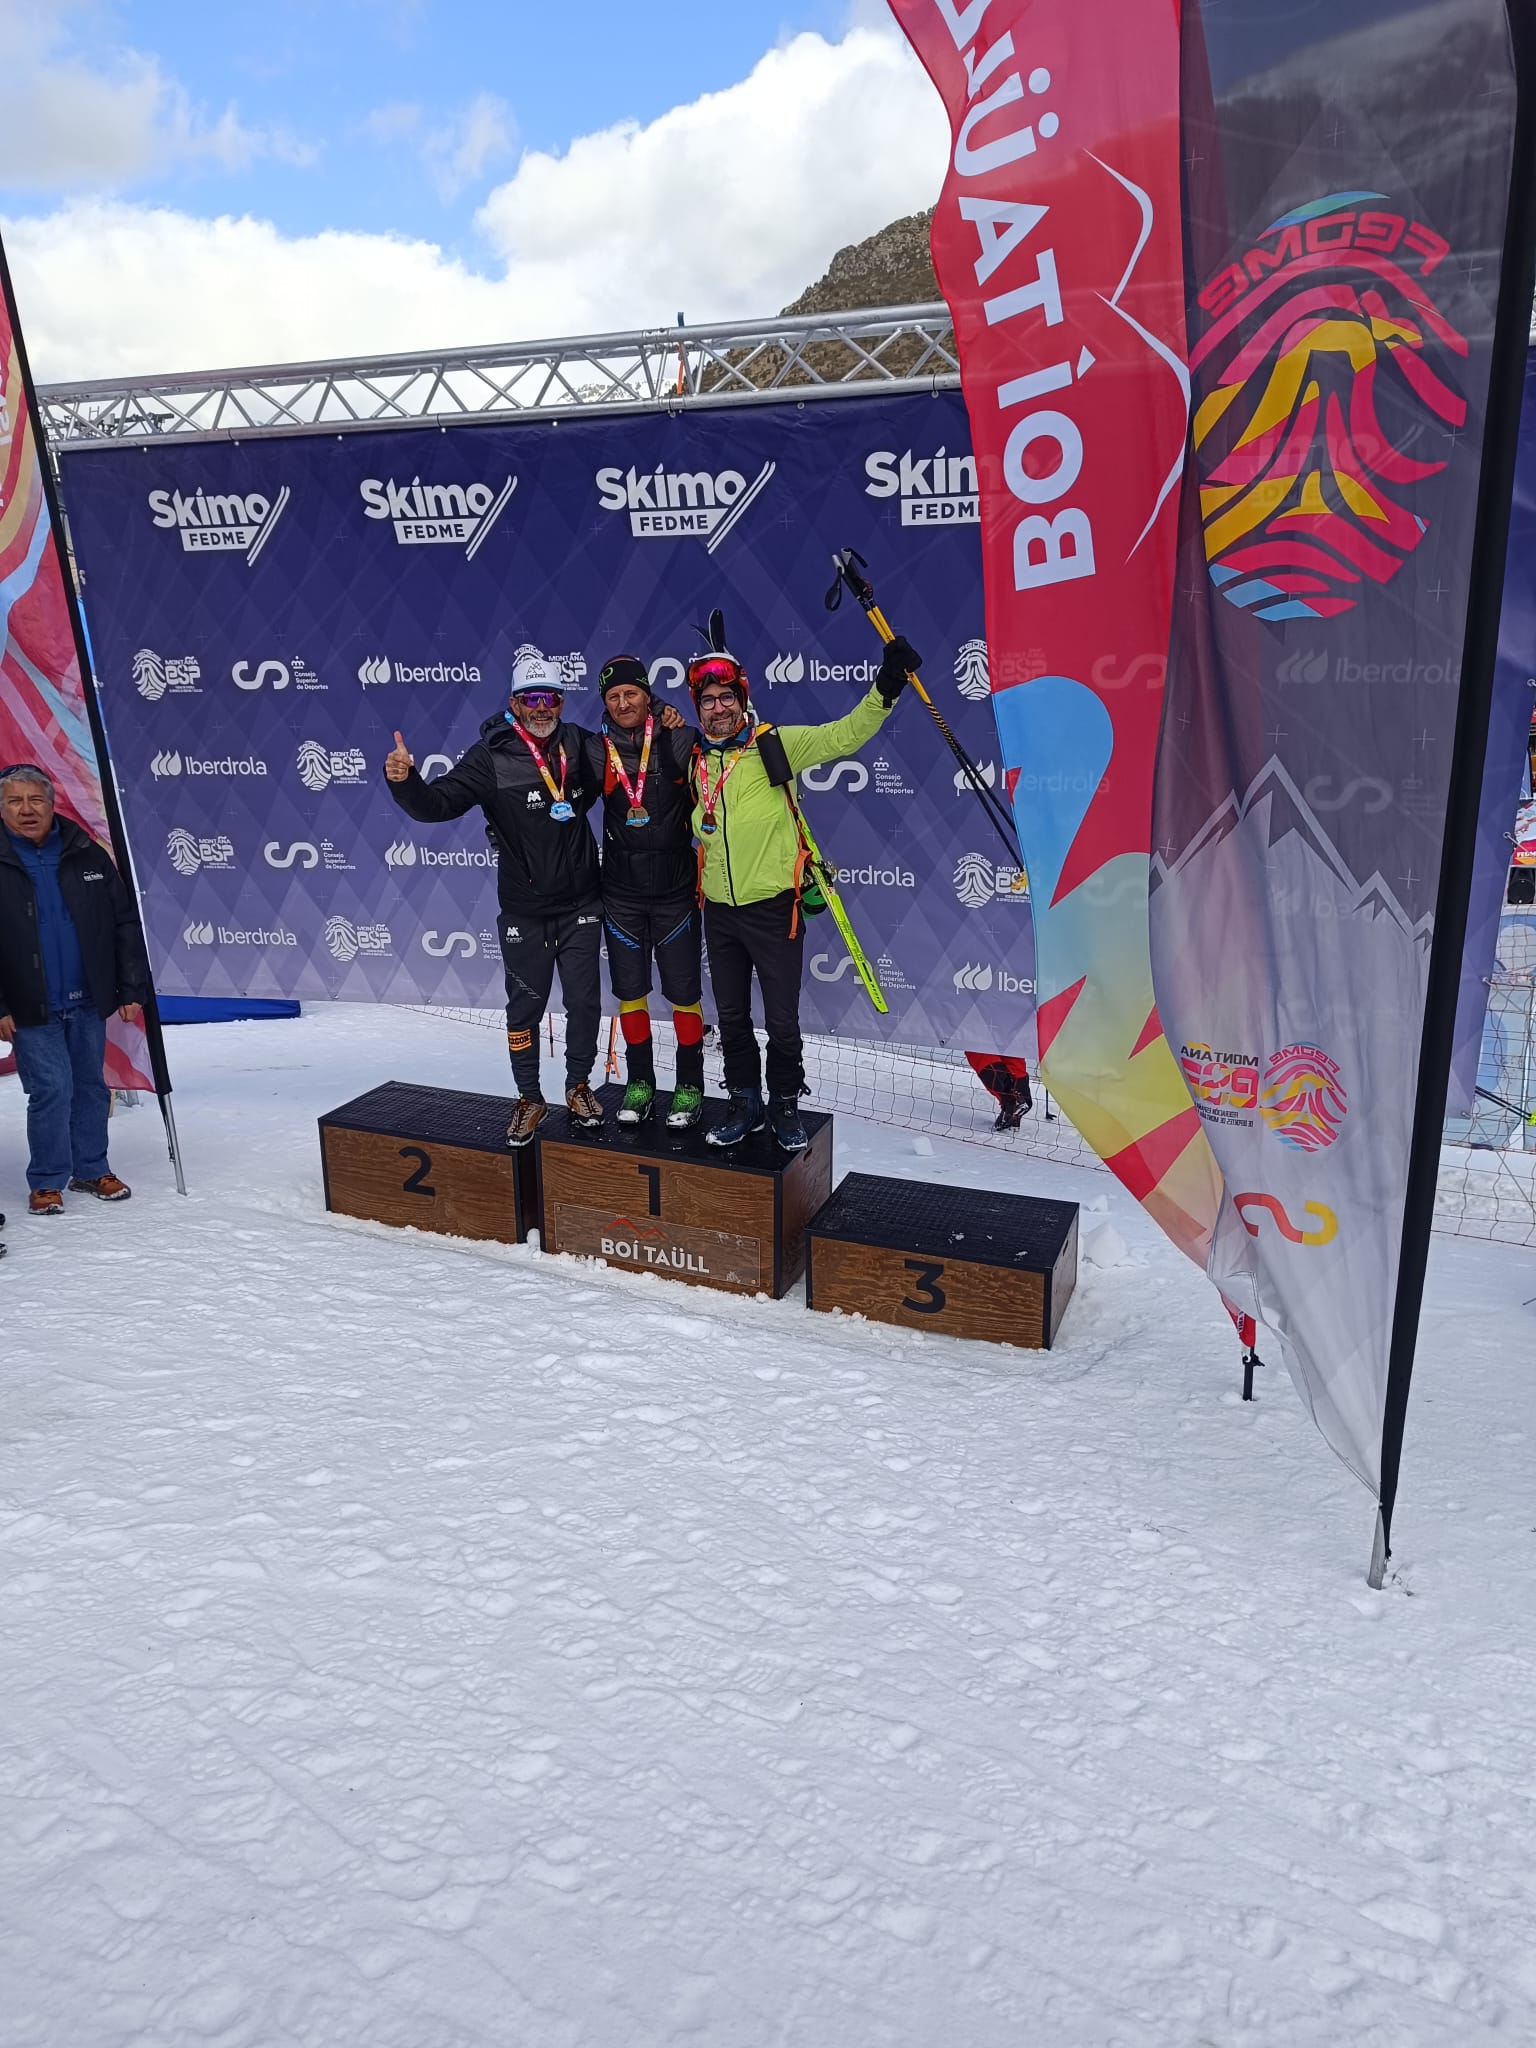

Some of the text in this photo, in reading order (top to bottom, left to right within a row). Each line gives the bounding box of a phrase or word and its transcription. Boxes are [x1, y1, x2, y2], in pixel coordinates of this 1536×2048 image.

[403, 523, 466, 540] FEDME
[640, 514, 709, 532] FEDME
[189, 530, 246, 547] FEDME
[396, 661, 481, 683] Iberdrola
[186, 755, 267, 776] Iberdrola
[875, 773, 901, 781] Consejo
[876, 780, 903, 788] Superior
[831, 866, 915, 887] erdrola
[218, 926, 297, 946] Iberdrola
[879, 969, 903, 977] Consejo
[879, 975, 905, 984] Superior
[888, 982, 916, 990] Deportes
[400, 1147, 435, 1198] 2
[637, 1164, 661, 1216] 1
[601, 1238, 710, 1275] BOÍ TAÜLL
[901, 1259, 947, 1313] 3
